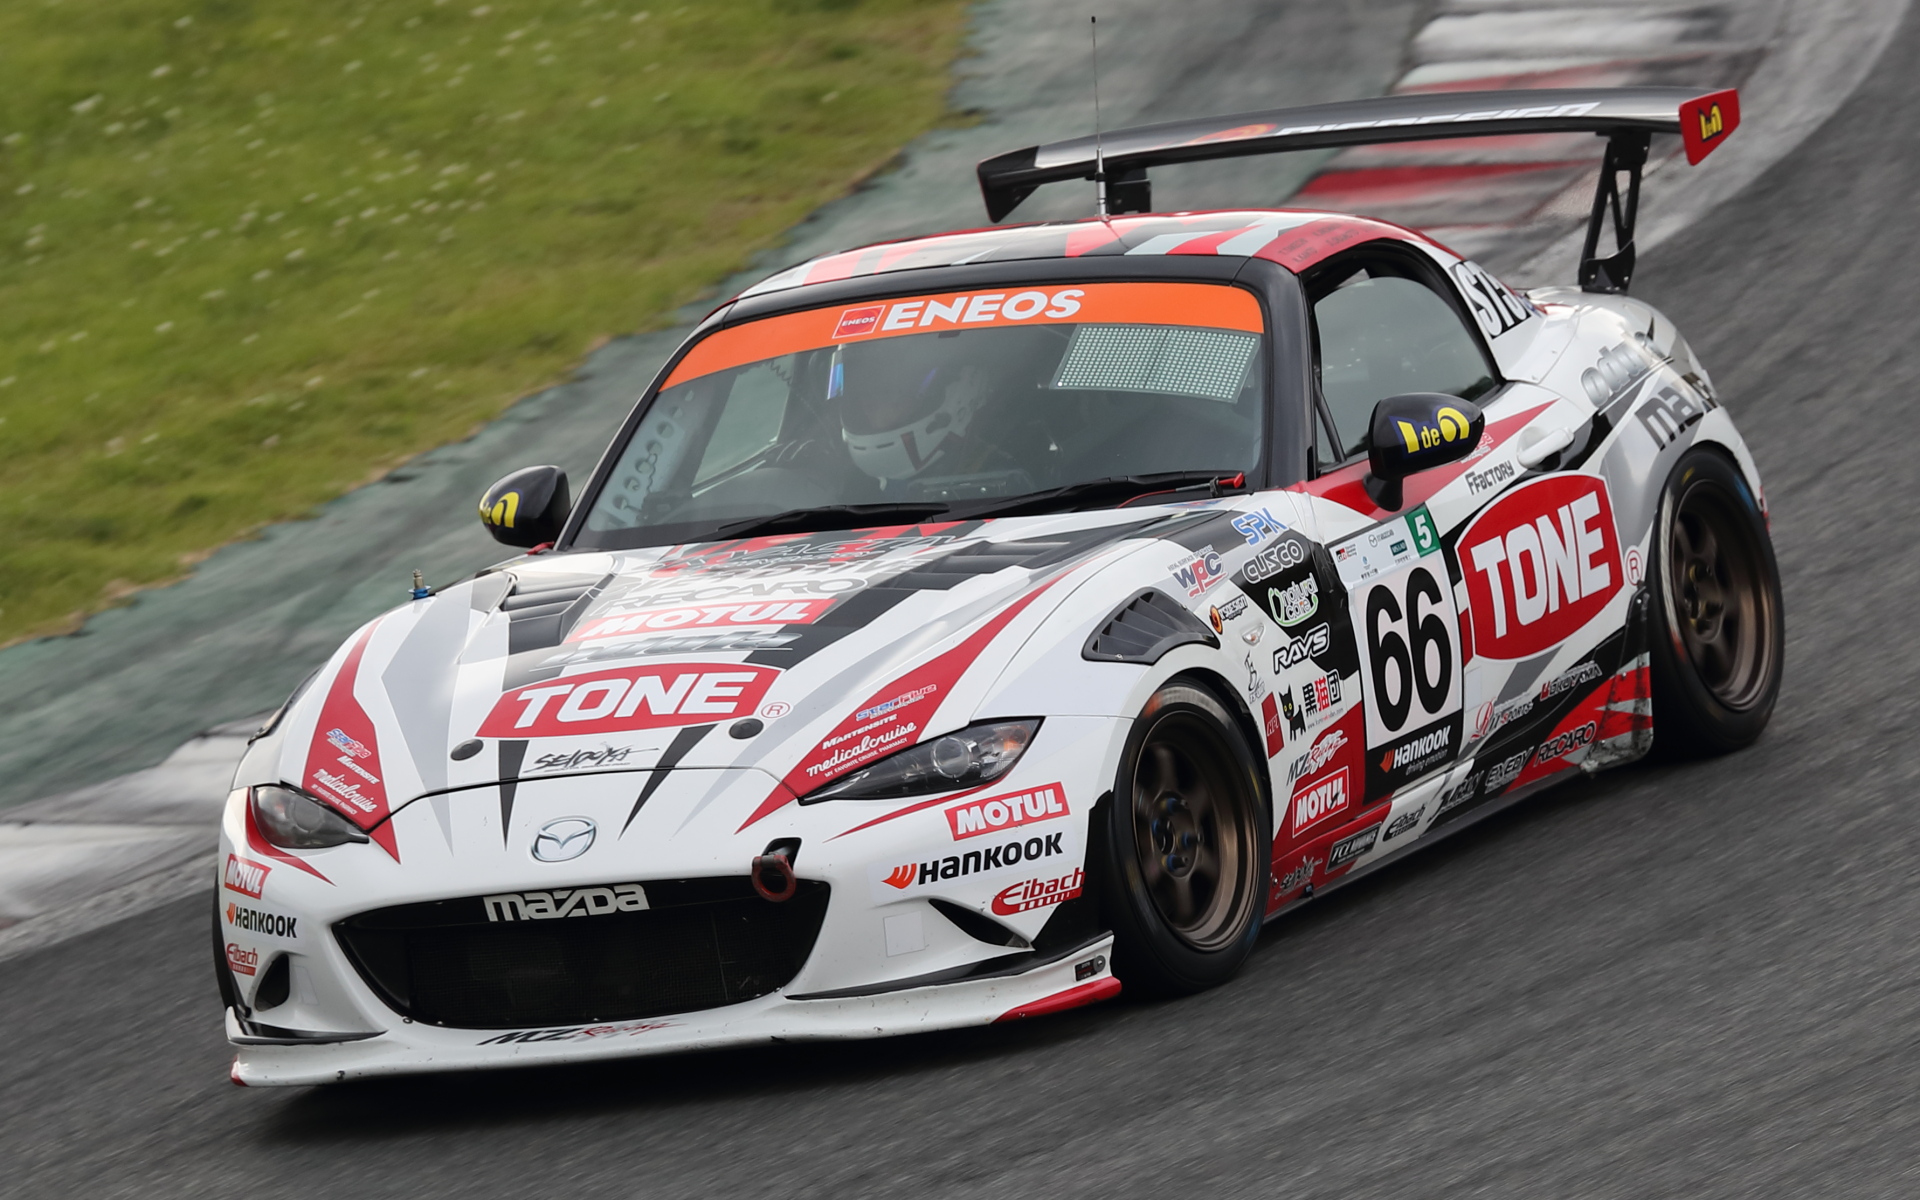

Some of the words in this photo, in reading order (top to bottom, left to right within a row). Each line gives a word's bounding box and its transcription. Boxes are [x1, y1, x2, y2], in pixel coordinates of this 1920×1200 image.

[842, 316, 875, 326] ENEOS
[882, 290, 1085, 331] ENEOS
[1231, 507, 1289, 545] SPK
[1415, 514, 1432, 549] 5
[1243, 540, 1304, 583] CUSCO
[1470, 491, 1611, 639] TONE
[592, 578, 868, 615] RECARO
[1281, 573, 1318, 606] natural
[577, 602, 809, 639] MOTUL
[1274, 629, 1327, 673] RAYS
[1366, 567, 1450, 732] 66
[513, 672, 758, 728] TONE
[1534, 719, 1597, 767] RECARO
[956, 789, 1063, 835] MOTUL
[1296, 776, 1347, 829] MOTUL
[225, 859, 264, 894] MOTUL
[992, 867, 1085, 916] Eibach
[227, 943, 258, 966] Eibach
